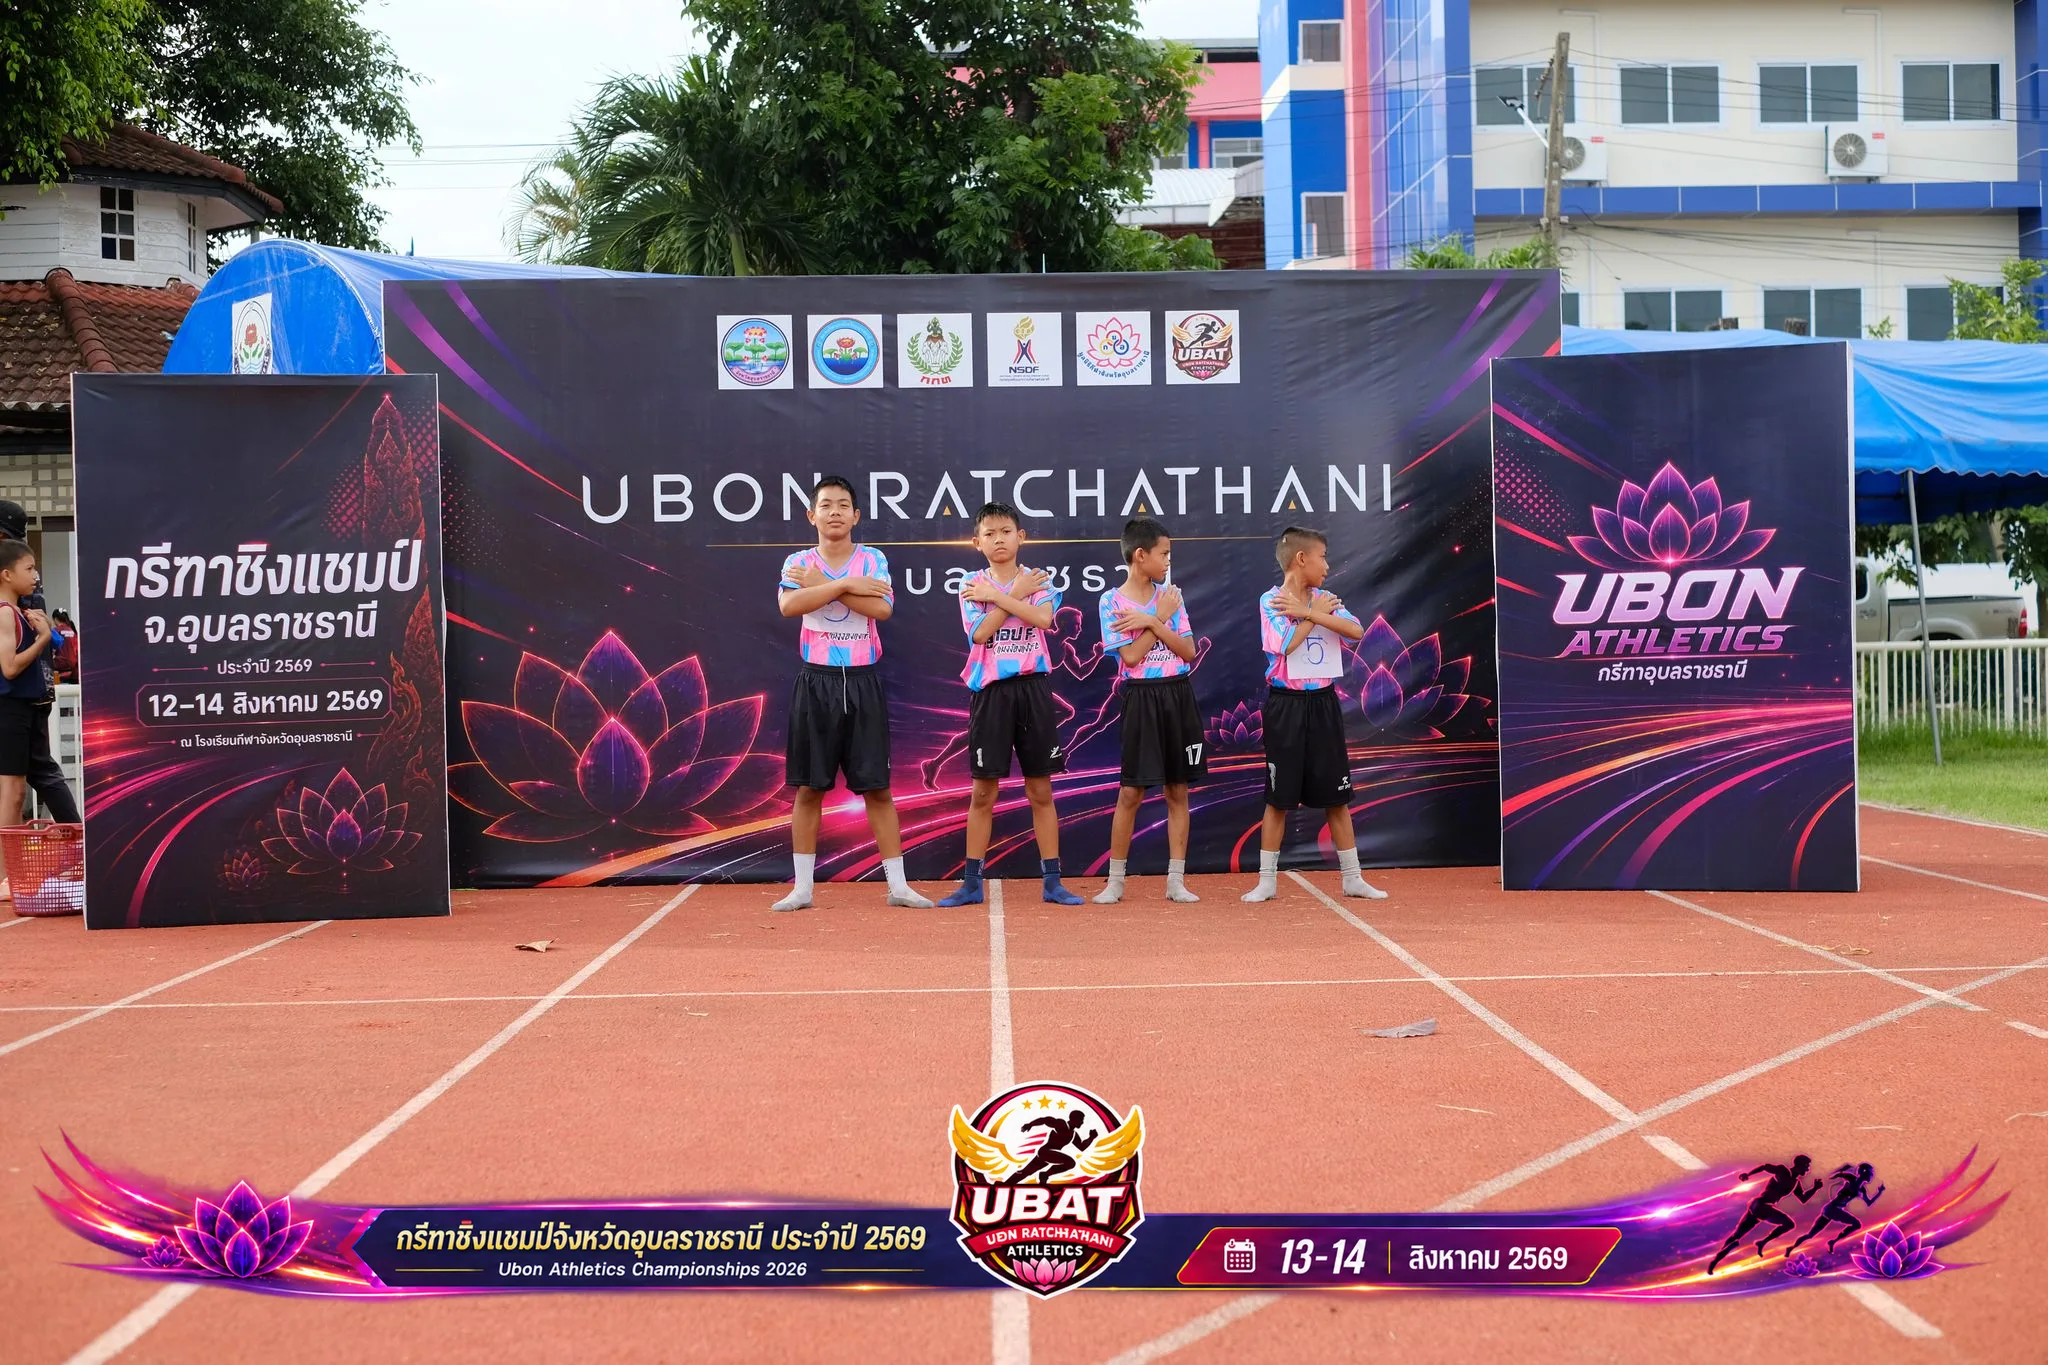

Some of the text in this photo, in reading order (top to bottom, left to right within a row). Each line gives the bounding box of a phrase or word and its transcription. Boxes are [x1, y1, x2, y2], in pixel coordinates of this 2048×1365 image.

[1177, 347, 1228, 361] UBAT
[920, 375, 952, 385] กกท
[1008, 366, 1040, 374] NSDF
[582, 463, 1391, 524] UBON RATCHATHANI
[105, 538, 422, 599] กรีฑาชิงแชมป์
[1552, 567, 1806, 626] UBON
[144, 600, 378, 654] จ.อุบลราชธานี
[1306, 637, 1325, 665] 5
[1553, 625, 1795, 659] ATHLETICS
[217, 657, 313, 675] ประจำปี 2569
[1598, 659, 1748, 686] กรีฑาอุบลราชธานี
[233, 691, 318, 715] สิงหาคม
[326, 689, 383, 712] 2569
[180, 738, 192, 748] ณ
[1185, 742, 1203, 766] 17
